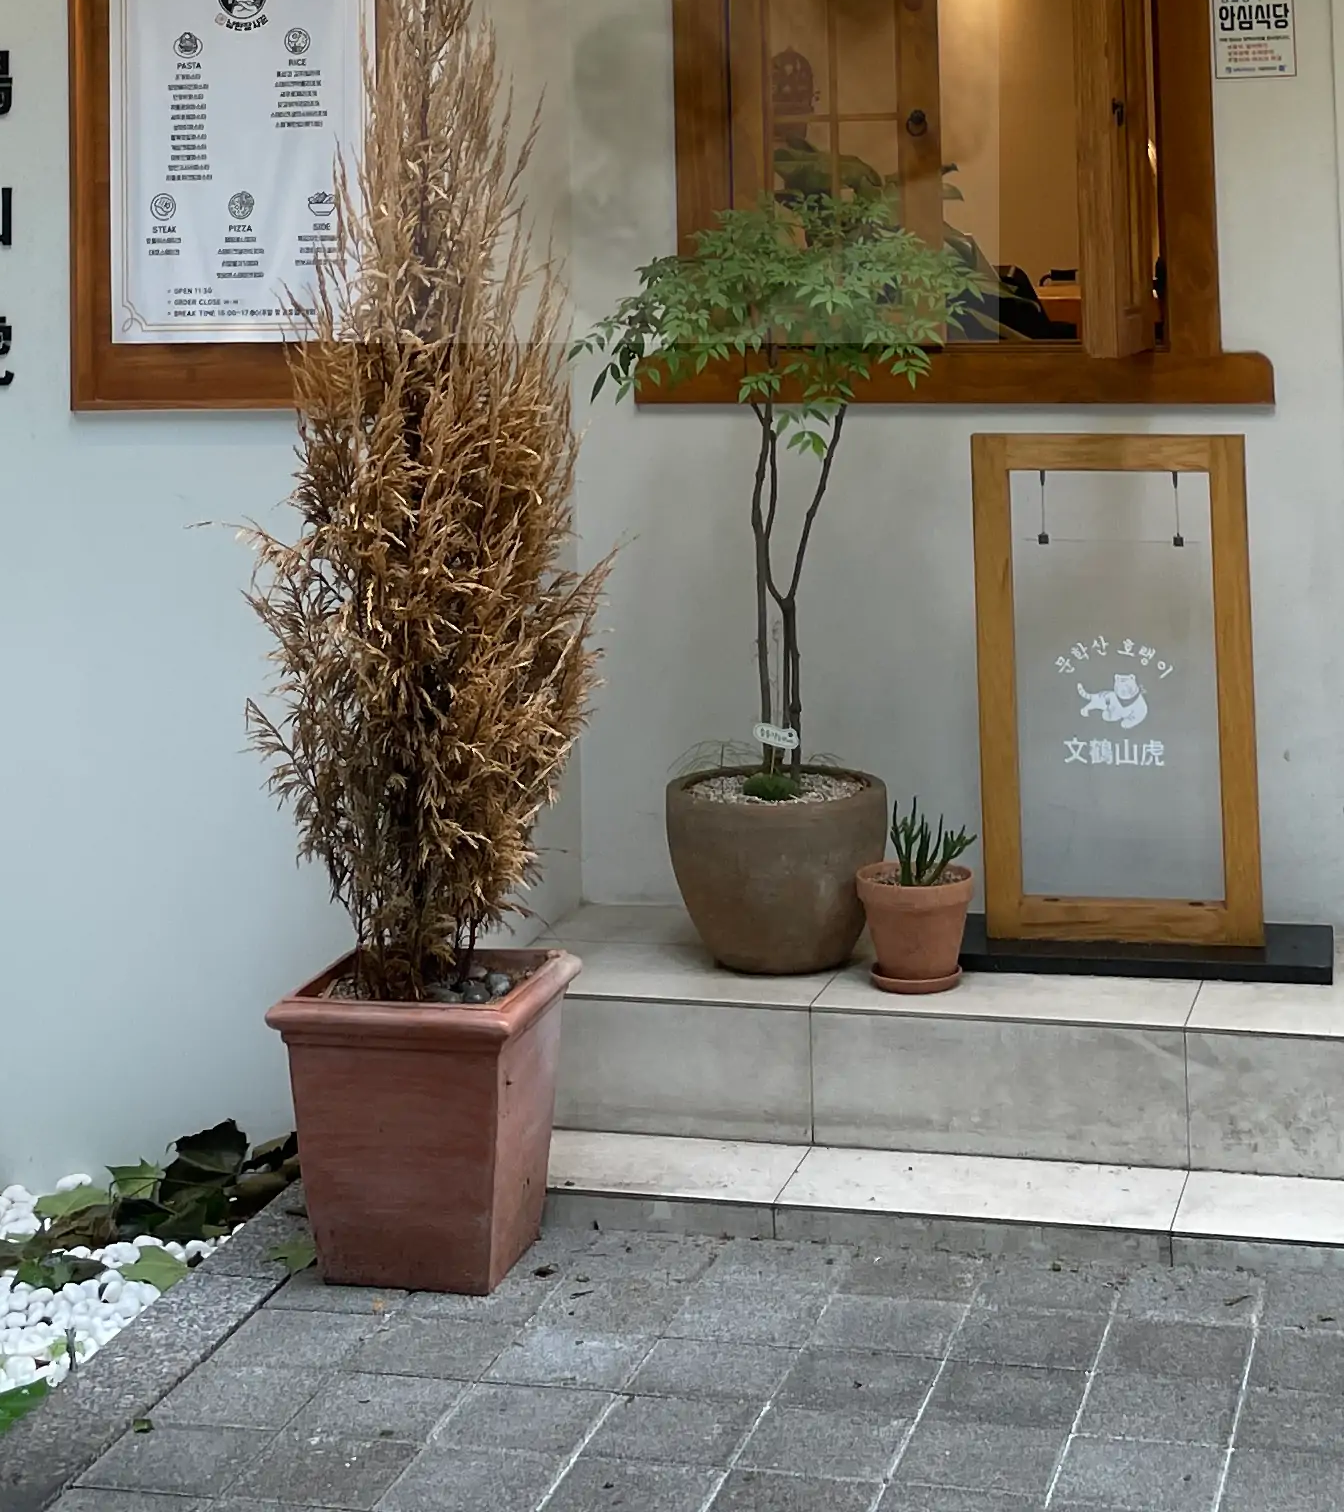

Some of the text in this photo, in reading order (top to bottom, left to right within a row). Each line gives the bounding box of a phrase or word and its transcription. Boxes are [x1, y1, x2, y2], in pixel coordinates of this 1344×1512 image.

[1218, 2, 1290, 32] 안심식당
[176, 61, 202, 70] PASTA
[288, 58, 307, 67] RICE
[152, 225, 177, 234] STEAK
[228, 224, 253, 233] PIZZA
[1055, 635, 1174, 680] 문학산 호랭이
[1063, 737, 1165, 767] 文鶴山虎
